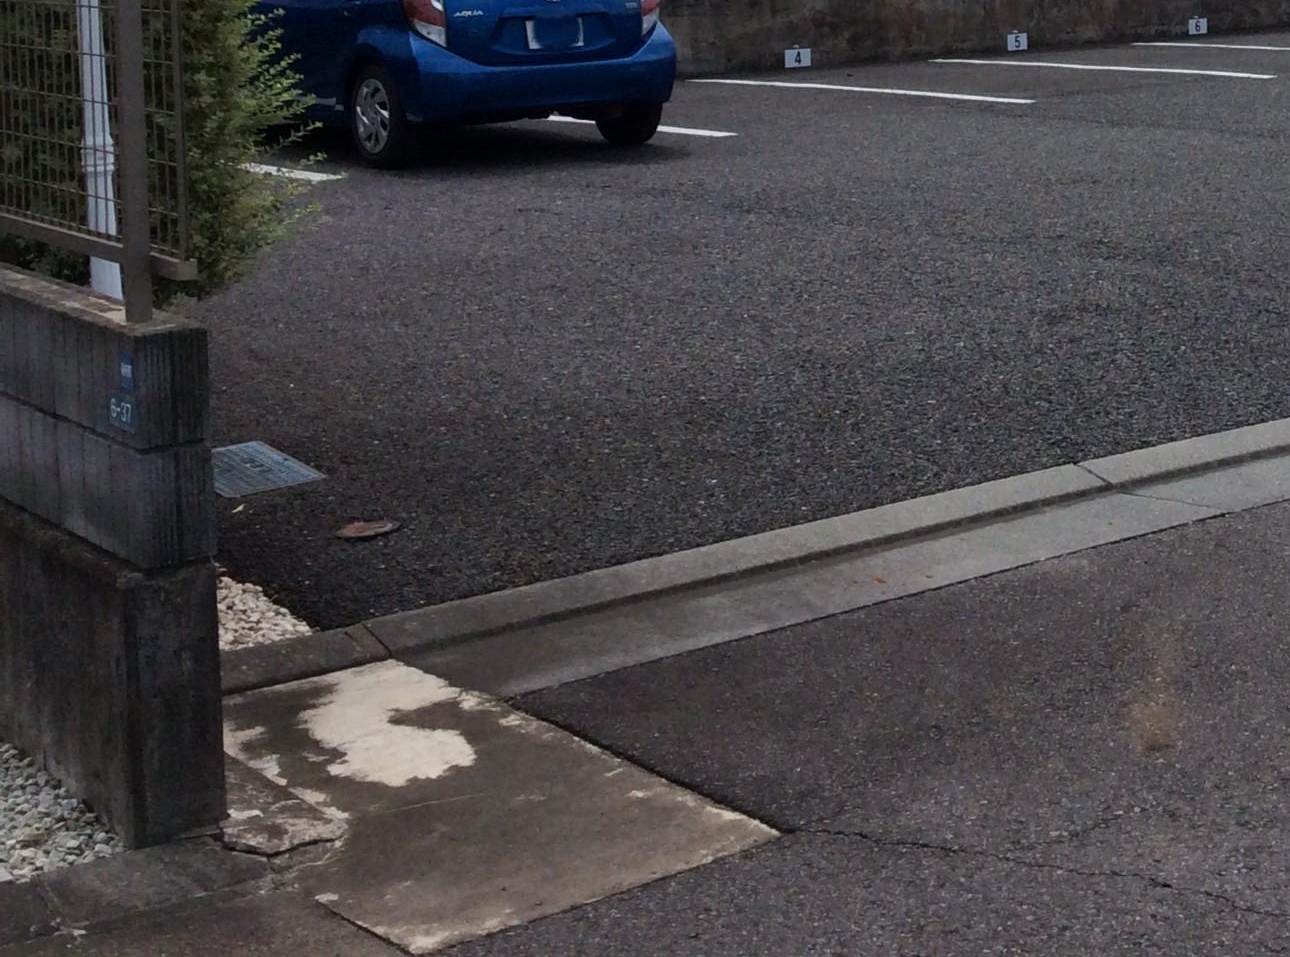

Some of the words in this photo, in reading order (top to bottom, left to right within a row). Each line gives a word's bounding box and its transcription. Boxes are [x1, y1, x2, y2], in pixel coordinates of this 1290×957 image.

[1194, 20, 1201, 33] 6
[1014, 35, 1021, 49] 5
[794, 51, 802, 65] 4
